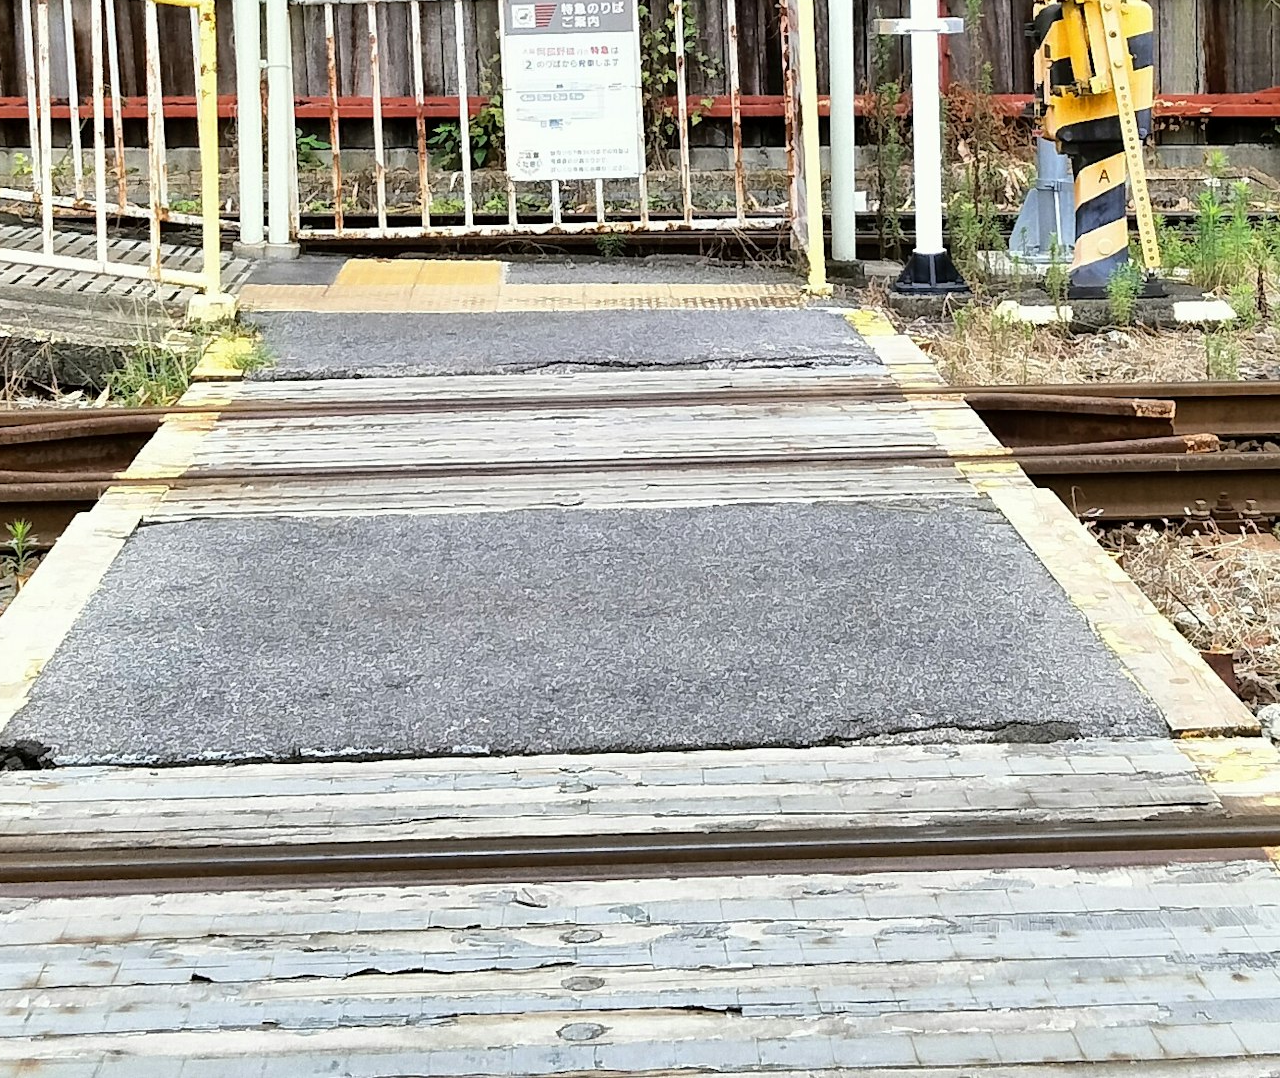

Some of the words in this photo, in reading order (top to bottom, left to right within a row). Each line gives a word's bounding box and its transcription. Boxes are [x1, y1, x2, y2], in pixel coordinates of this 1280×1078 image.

[561, 1, 624, 16] 特急のりば
[561, 15, 601, 28] ご案内
[1098, 169, 1111, 183] A
